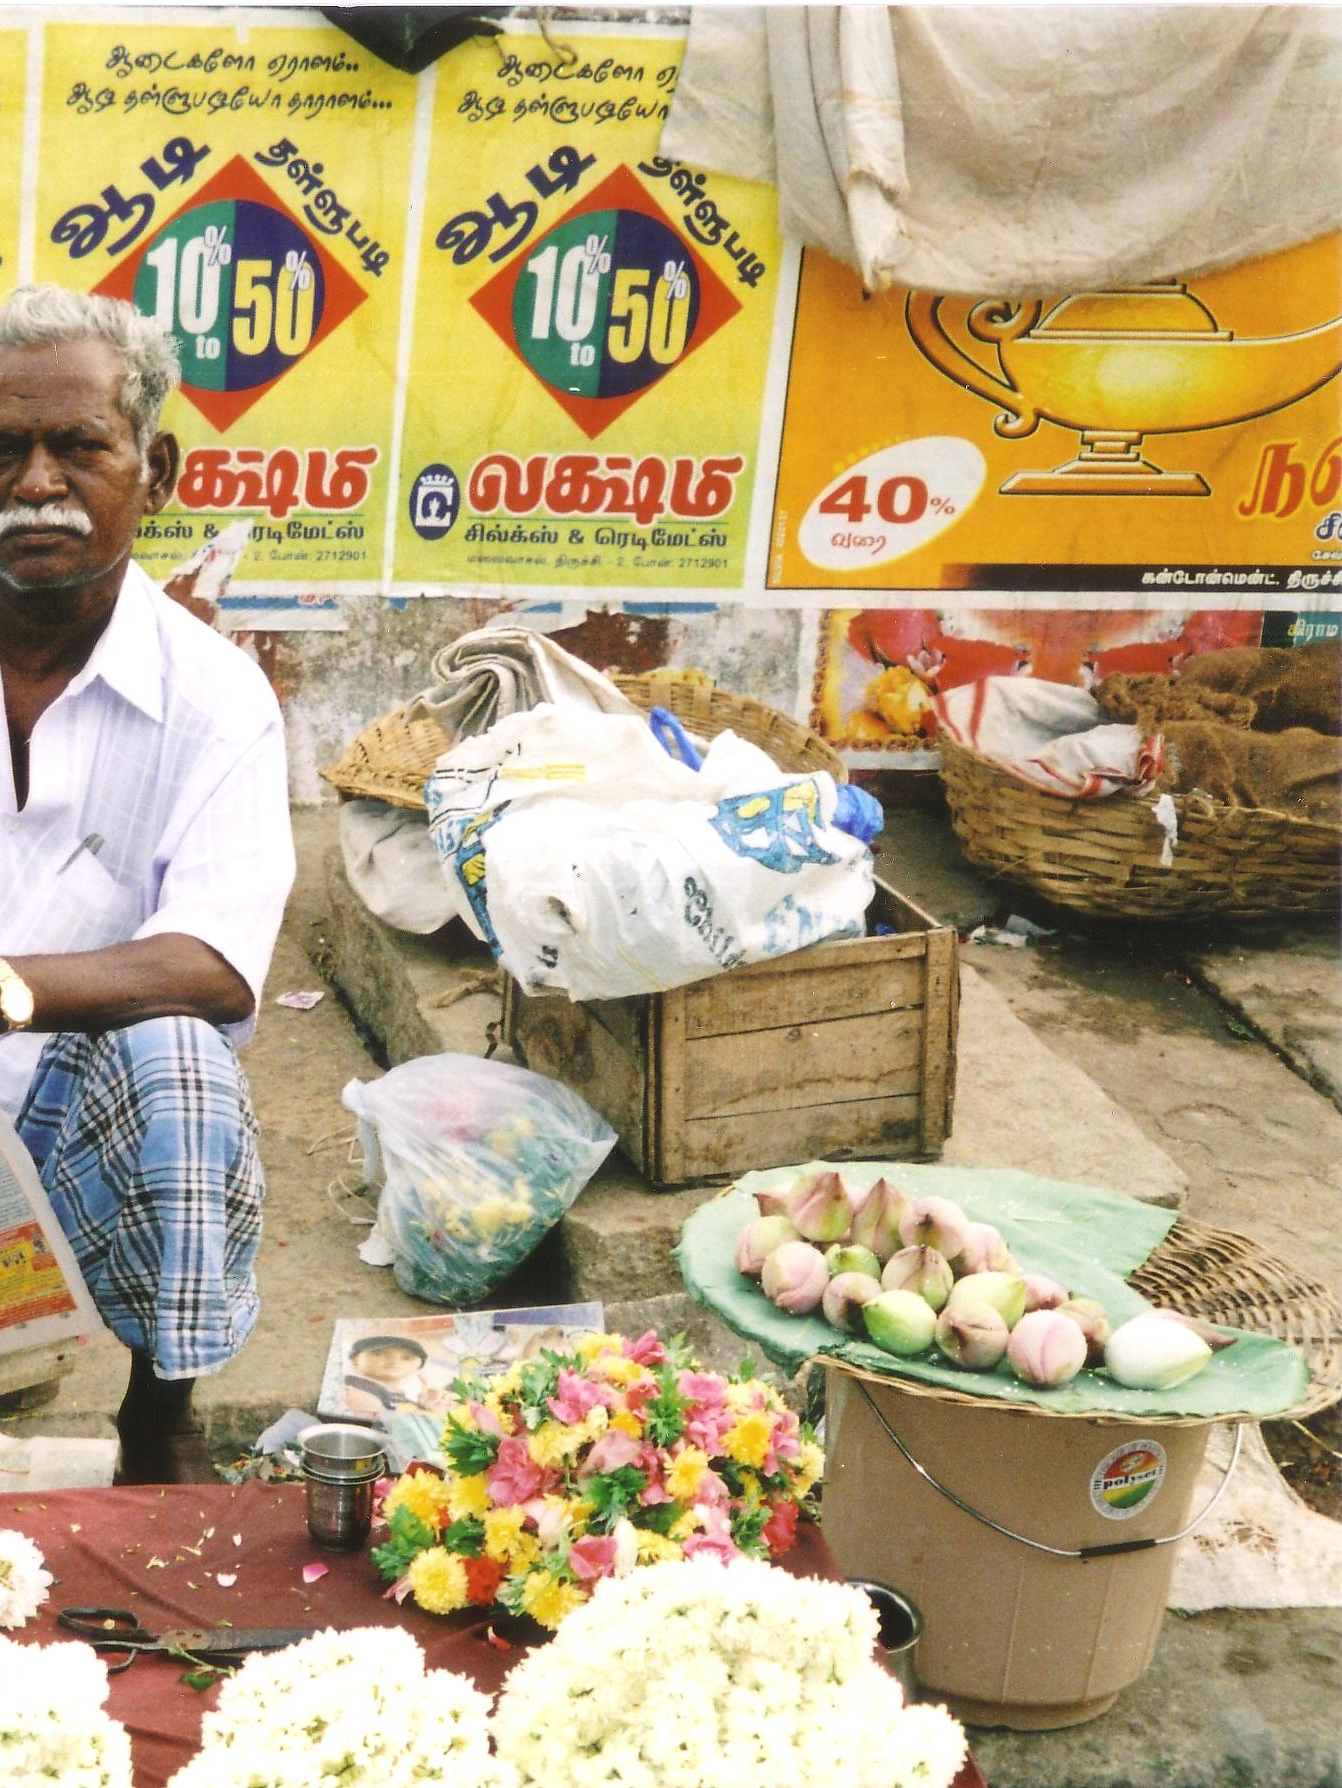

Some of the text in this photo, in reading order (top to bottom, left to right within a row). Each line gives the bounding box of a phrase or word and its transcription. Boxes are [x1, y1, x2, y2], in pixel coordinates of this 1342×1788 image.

[106, 45, 255, 77] ஆடைகளோ
[67, 81, 117, 114] ஆடி
[458, 90, 506, 122] ஆடி
[50, 136, 390, 277] ஆடி தள்ளுபடி
[435, 145, 597, 265] ஆடி
[147, 225, 315, 359] 10% to 50%
[527, 234, 691, 366] 10% to 50%
[819, 474, 955, 525] 40%
[464, 524, 727, 550] சில்க்ஸ் & ரெடிமேட்ஸ்
[831, 532, 887, 556] வரை
